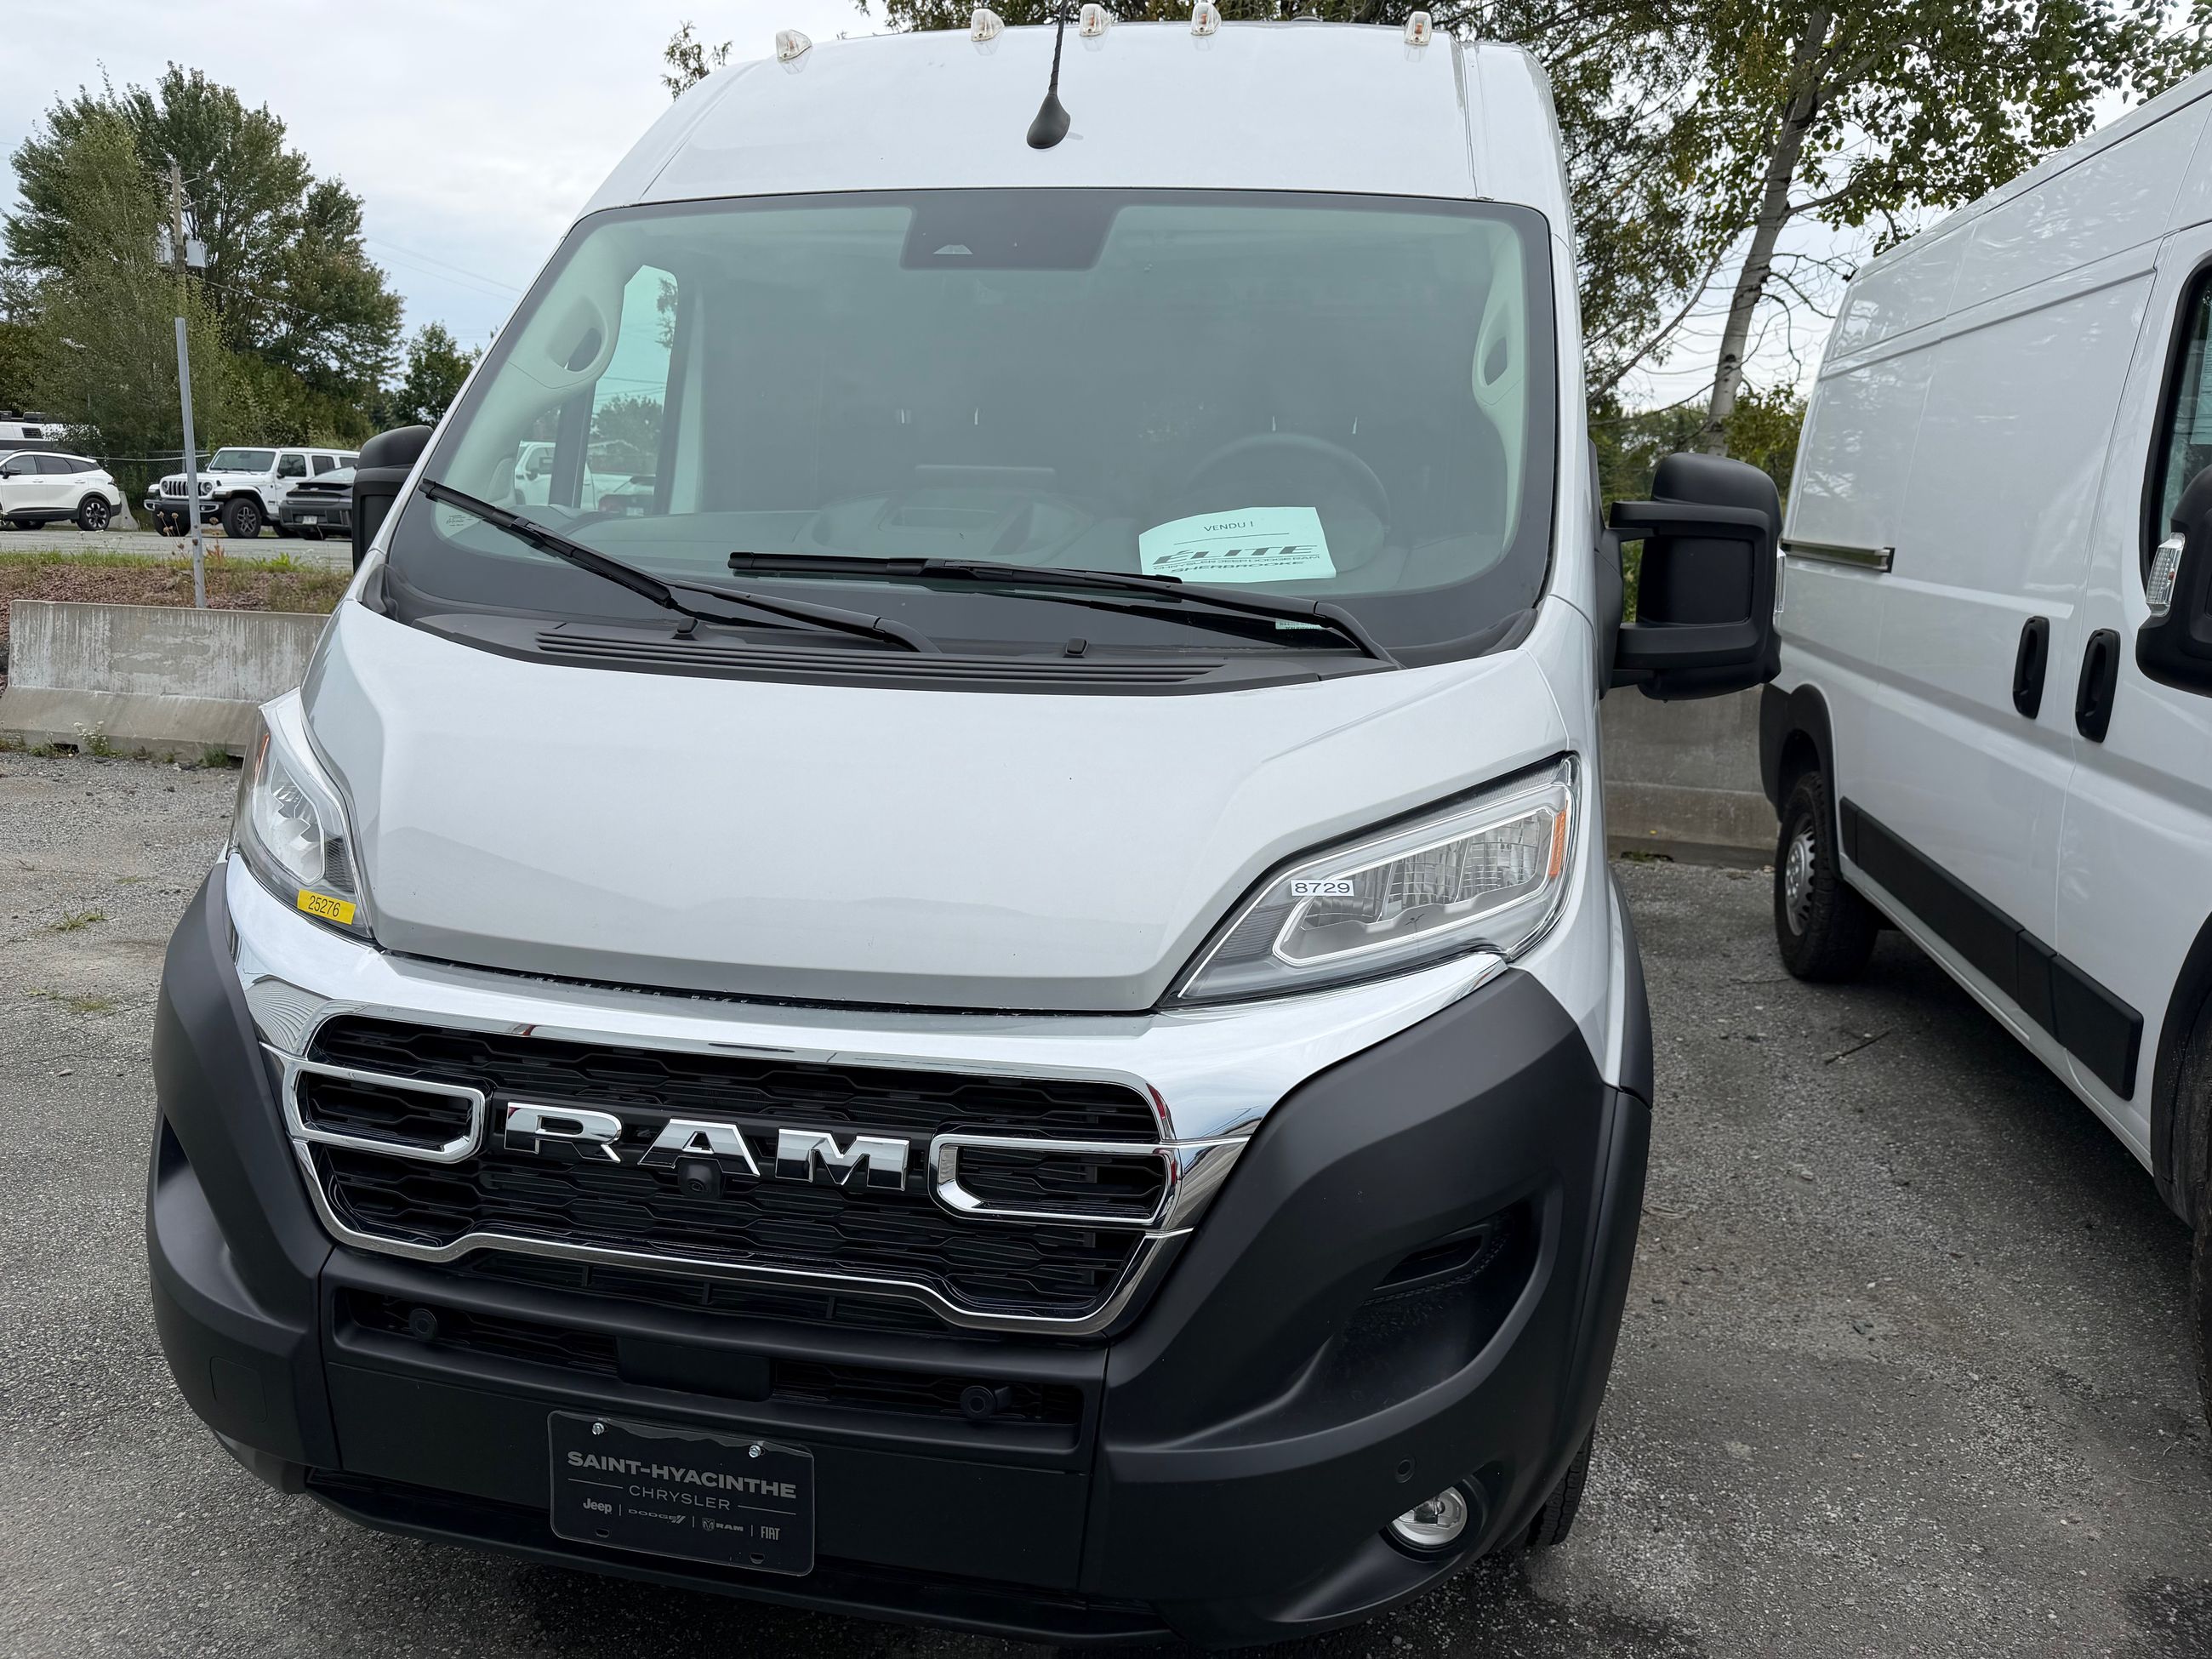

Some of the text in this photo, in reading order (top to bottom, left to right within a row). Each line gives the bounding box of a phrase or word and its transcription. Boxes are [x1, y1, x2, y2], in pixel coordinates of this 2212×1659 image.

[1204, 522, 1246, 531] VENDU
[1171, 562, 1304, 573] SHERBROOKE
[1294, 882, 1350, 893] 8729
[308, 895, 341, 917] 25276
[505, 1102, 910, 1192] RAM
[567, 1451, 796, 1499] SAINT-HYACINTHE
[629, 1485, 730, 1511] CHRYSLER
[583, 1497, 780, 1541] Jeep DODGE RAM FIAT
